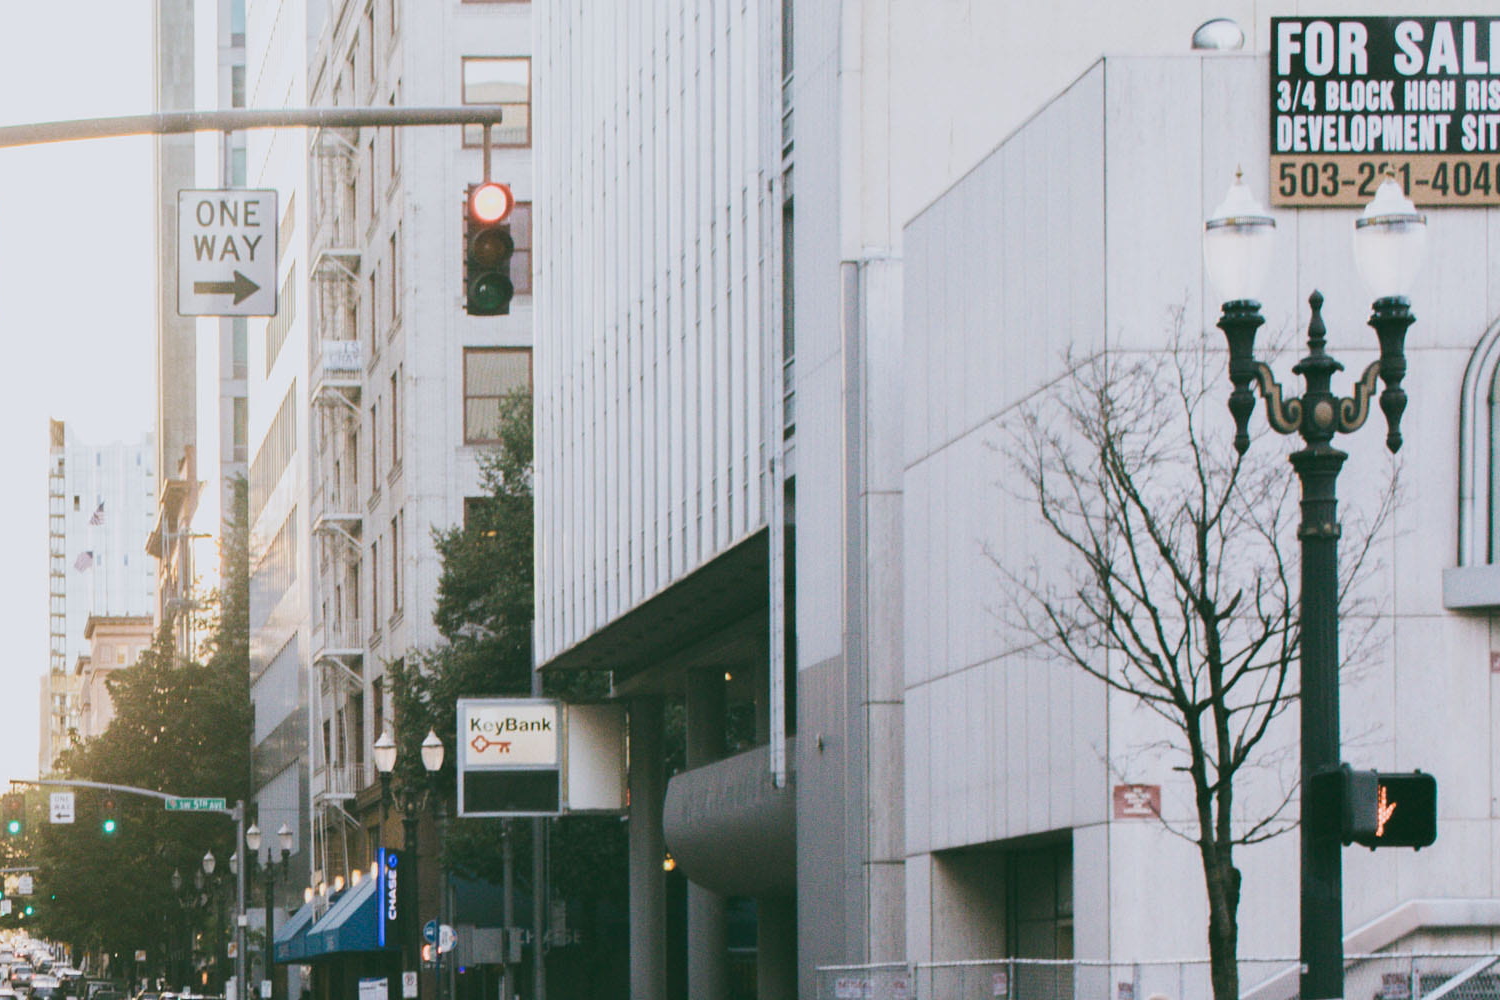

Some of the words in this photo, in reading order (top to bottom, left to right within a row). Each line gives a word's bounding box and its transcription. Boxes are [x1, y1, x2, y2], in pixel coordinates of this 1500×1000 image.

[1277, 21, 1368, 76] FOR
[1277, 80, 1316, 112] 3/4
[1325, 80, 1395, 112] BLOCK
[1404, 80, 1456, 112] HIGH
[1465, 80, 1500, 112] RIS
[1276, 114, 1451, 151] DEVELOPMENT
[1461, 114, 1500, 151] SIT
[1279, 161, 1500, 197] 503-21-404
[196, 200, 260, 227] ONE
[193, 235, 262, 261] WAY
[470, 718, 551, 735] KeyBank
[388, 869, 397, 921] CHASE
